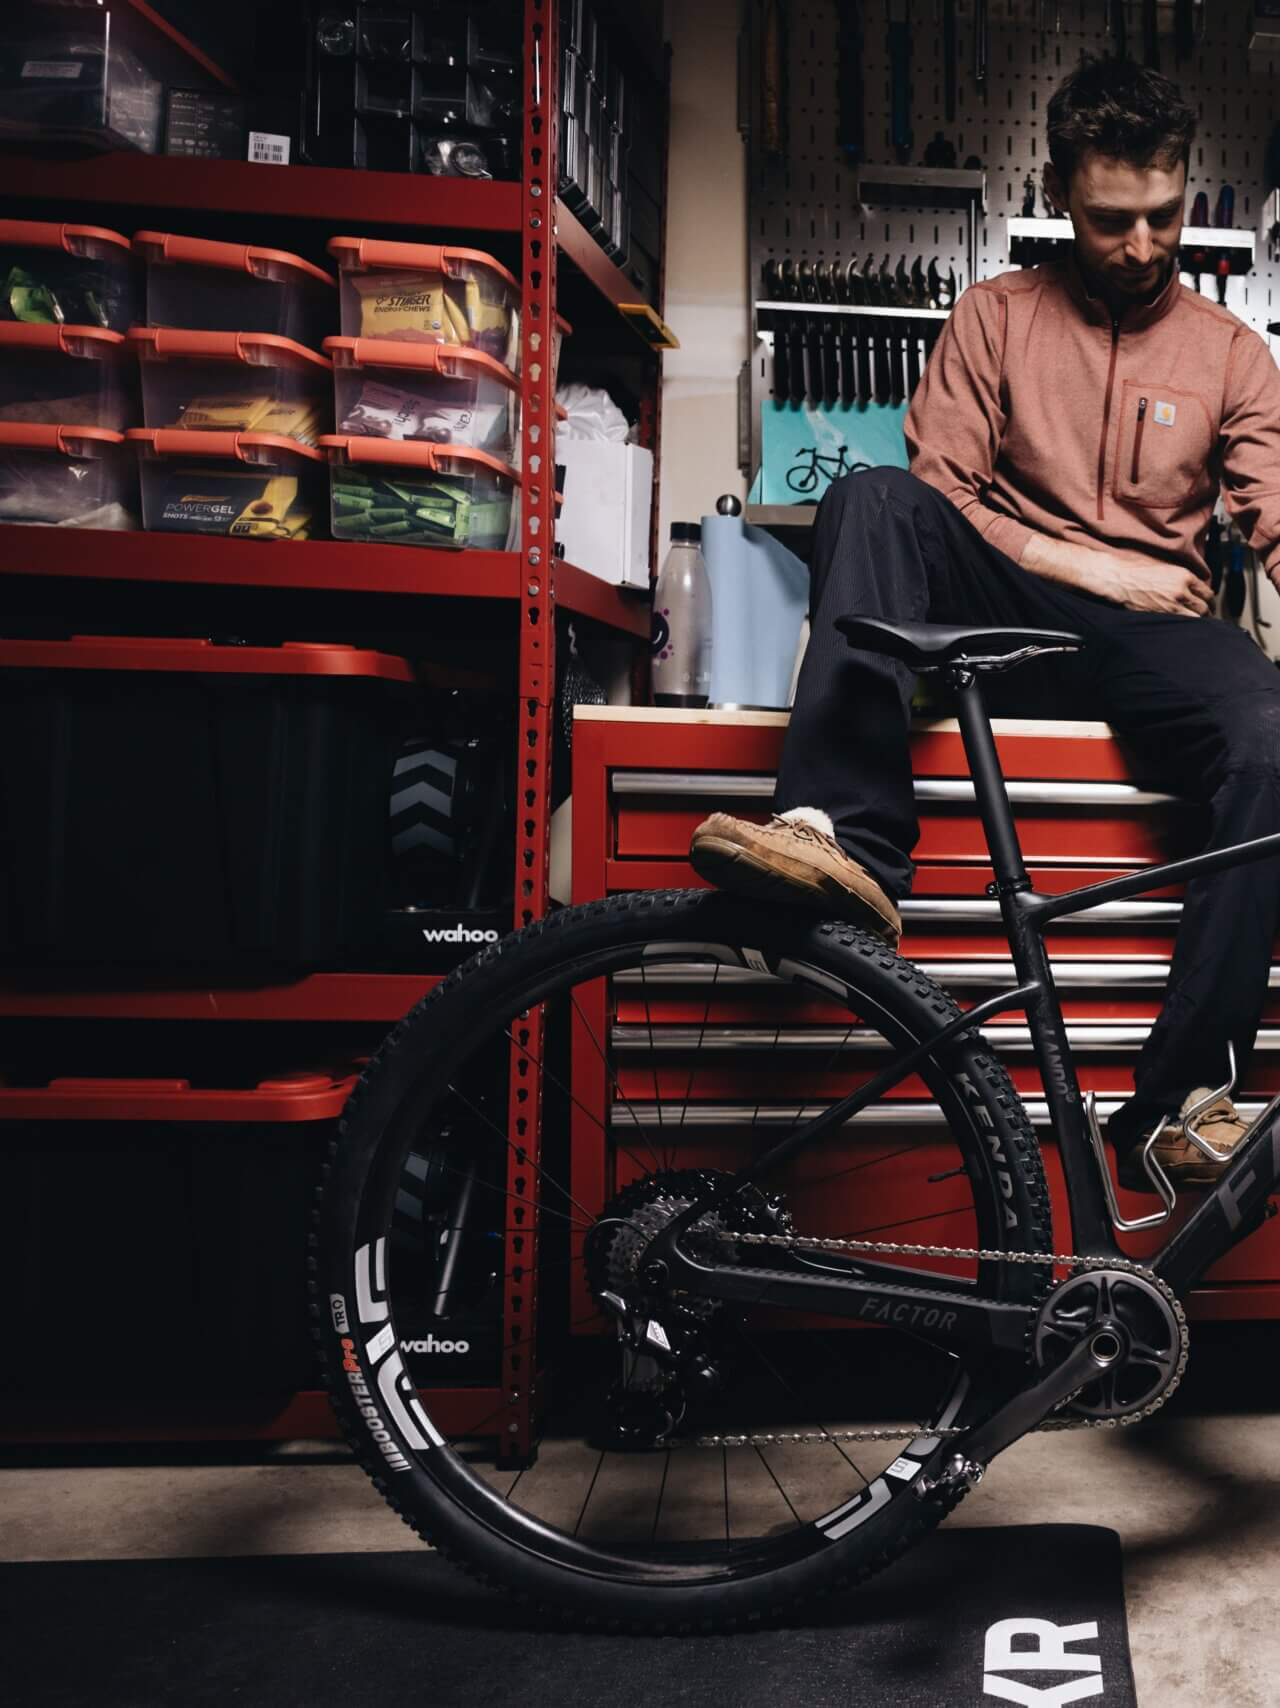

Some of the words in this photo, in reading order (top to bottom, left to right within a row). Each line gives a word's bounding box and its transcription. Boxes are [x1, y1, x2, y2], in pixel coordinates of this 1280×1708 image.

[165, 503, 236, 515] POWERGEL
[422, 923, 499, 943] wahoo
[955, 1073, 1018, 1229] KENDA
[860, 1297, 957, 1332] FACTOR
